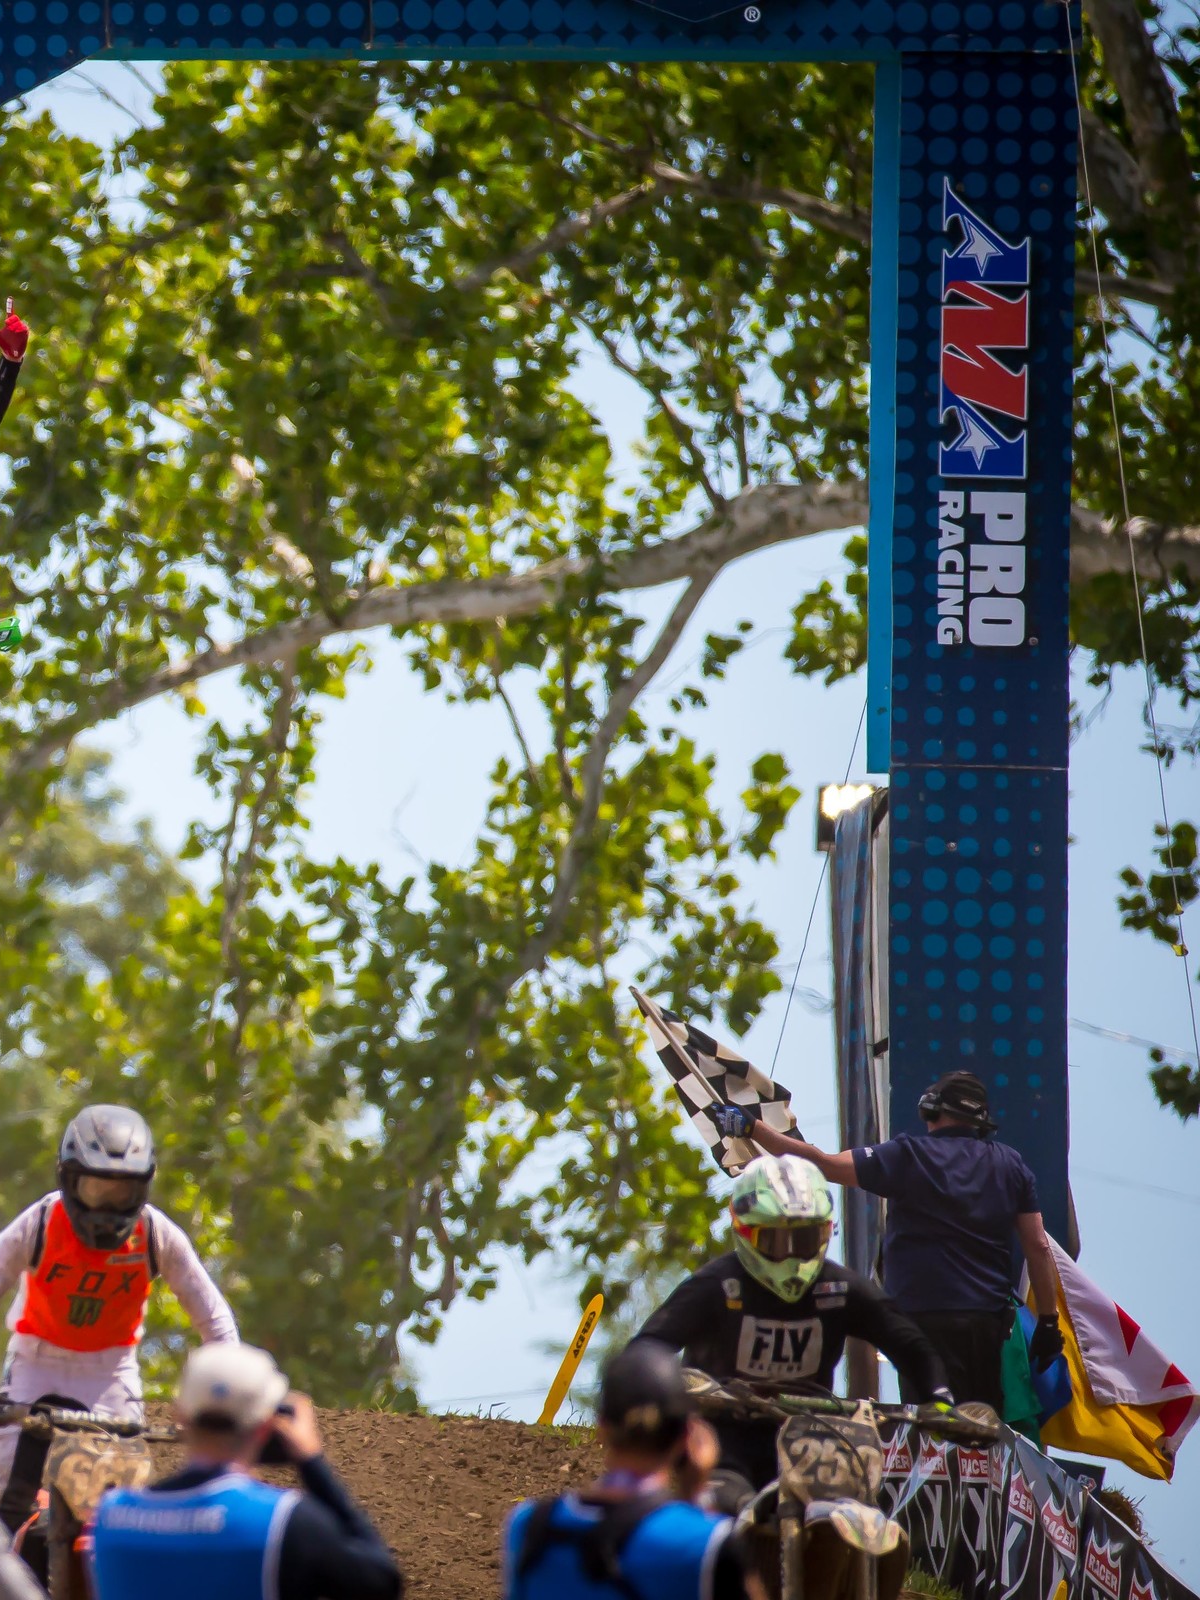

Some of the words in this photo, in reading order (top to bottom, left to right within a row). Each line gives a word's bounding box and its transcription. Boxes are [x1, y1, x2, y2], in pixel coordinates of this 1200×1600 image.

[939, 176, 1031, 479] AMA
[937, 490, 965, 645] RACING
[968, 491, 1027, 647] PRO
[45, 1263, 140, 1297] FOX
[751, 1325, 813, 1363] FLY
[961, 1459, 988, 1473] RACE
[1010, 1492, 1033, 1515] CER
[1041, 1515, 1076, 1550] RACER
[1088, 1557, 1119, 1592] RACER
